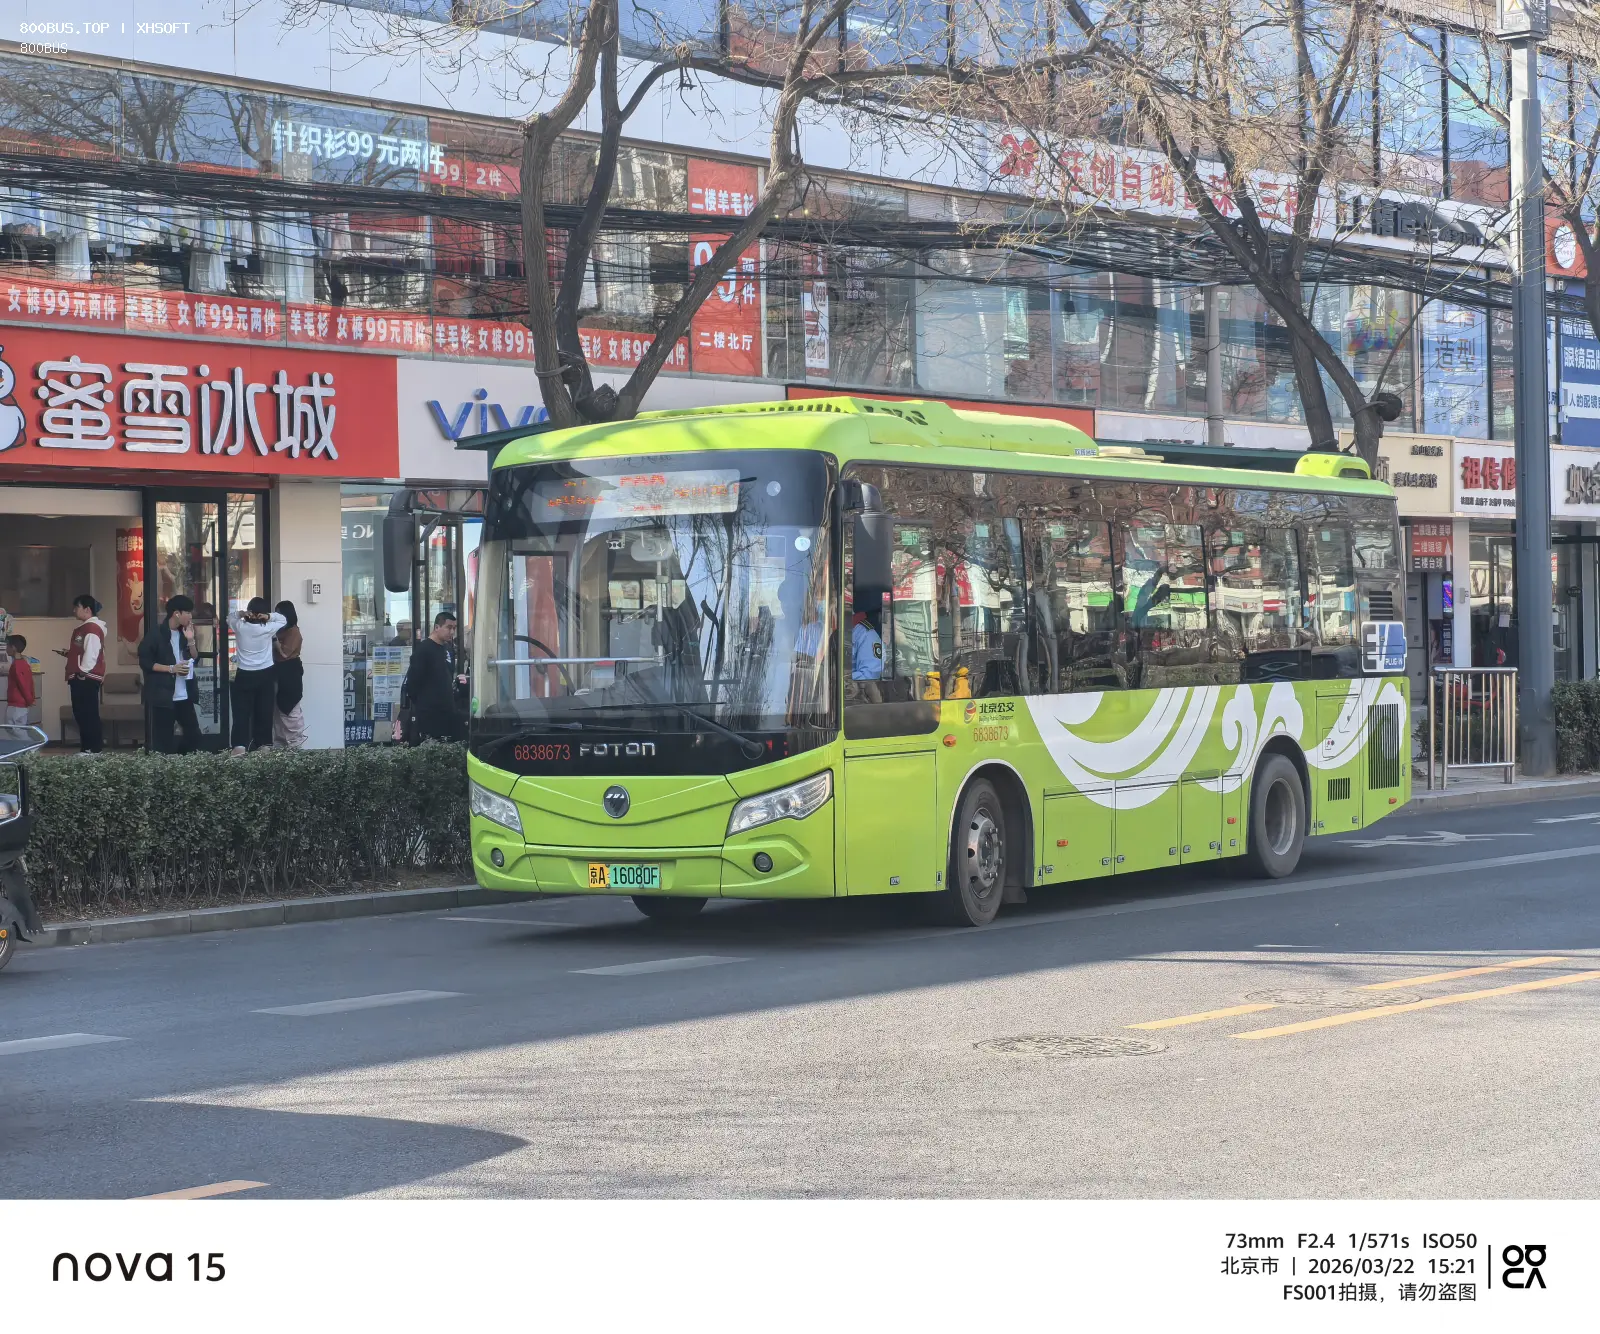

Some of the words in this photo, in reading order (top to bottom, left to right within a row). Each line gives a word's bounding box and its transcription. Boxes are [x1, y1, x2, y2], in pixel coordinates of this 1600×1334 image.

[8, 284, 117, 322] 女裤99元两件
[176, 299, 277, 335] 女裤99元两件
[699, 331, 754, 351] 二楼北厅
[36, 355, 339, 460] 蜜雪冰城
[1414, 557, 1443, 569] 三楼台球
[979, 701, 1015, 713] 北京公交
[973, 725, 1009, 742] 6838673
[514, 745, 571, 761] 6838673
[579, 743, 656, 757] FOTON
[590, 866, 607, 886] 京A
[612, 866, 660, 886] 16080F
